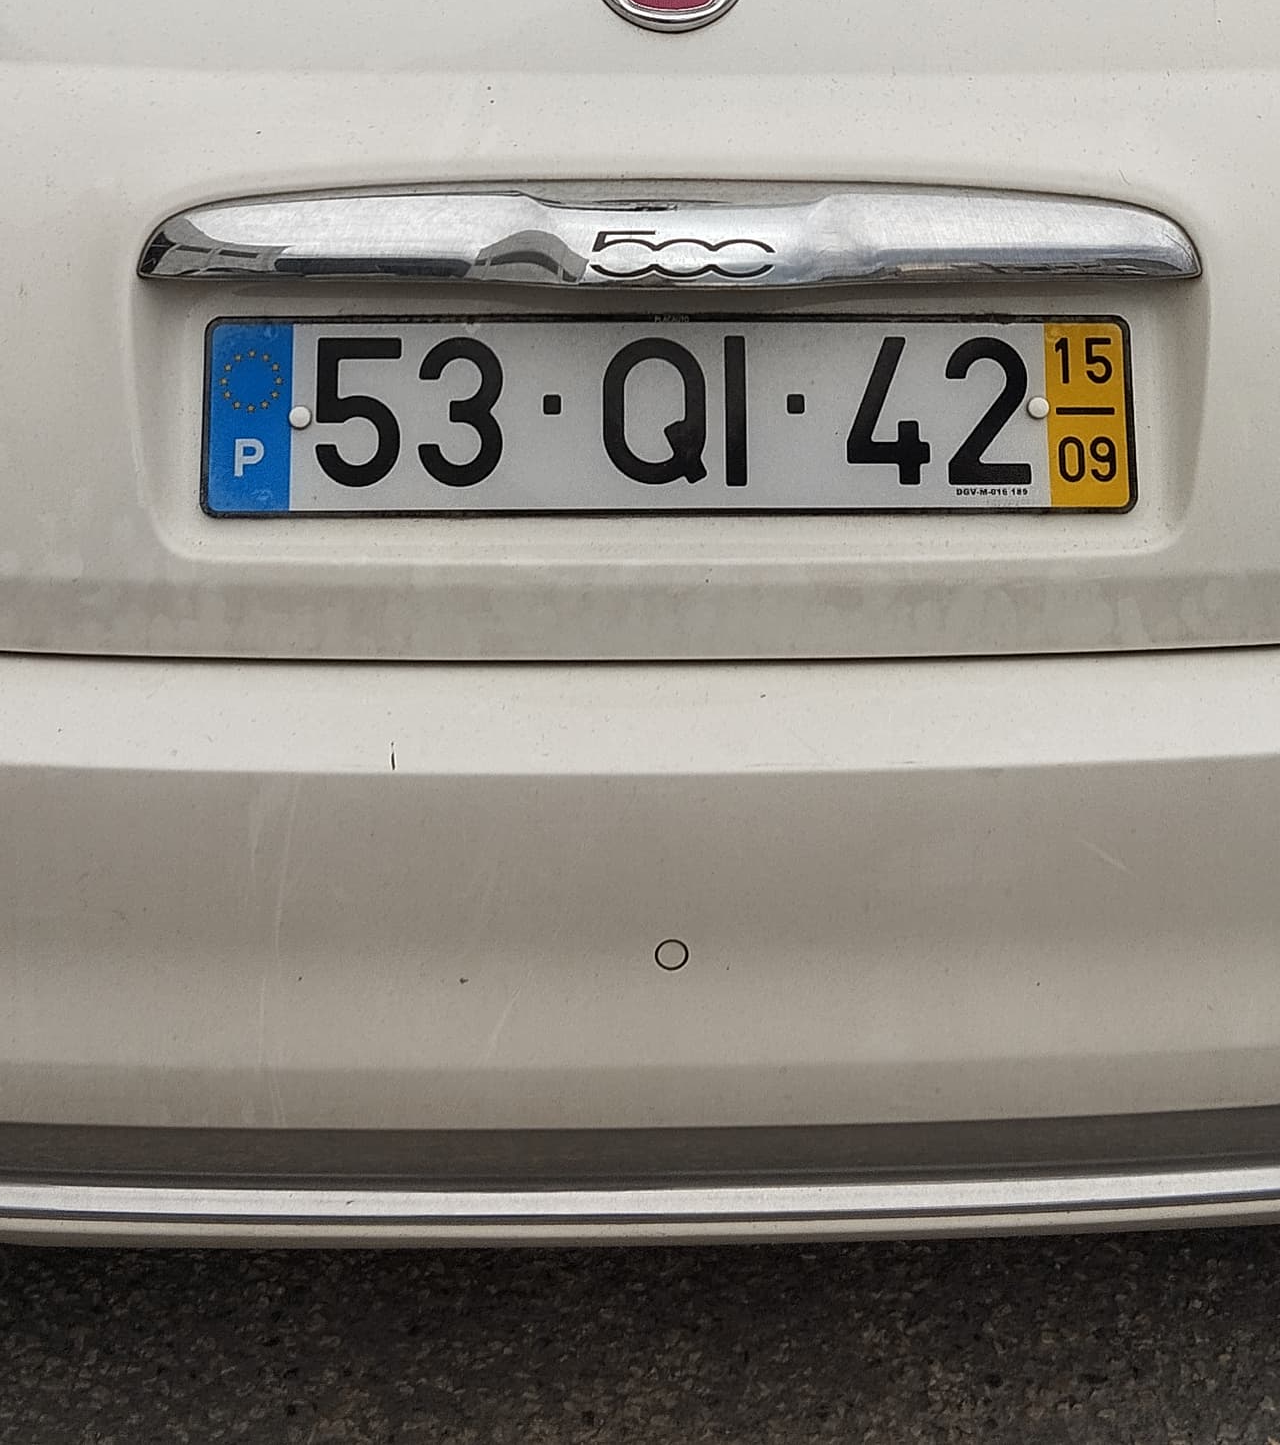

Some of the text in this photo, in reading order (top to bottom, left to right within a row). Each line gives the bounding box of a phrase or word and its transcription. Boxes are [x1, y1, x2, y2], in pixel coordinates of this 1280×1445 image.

[589, 230, 777, 278] 500
[1054, 337, 1114, 385] 15
[233, 438, 265, 477] P
[1057, 435, 1118, 484] 09
